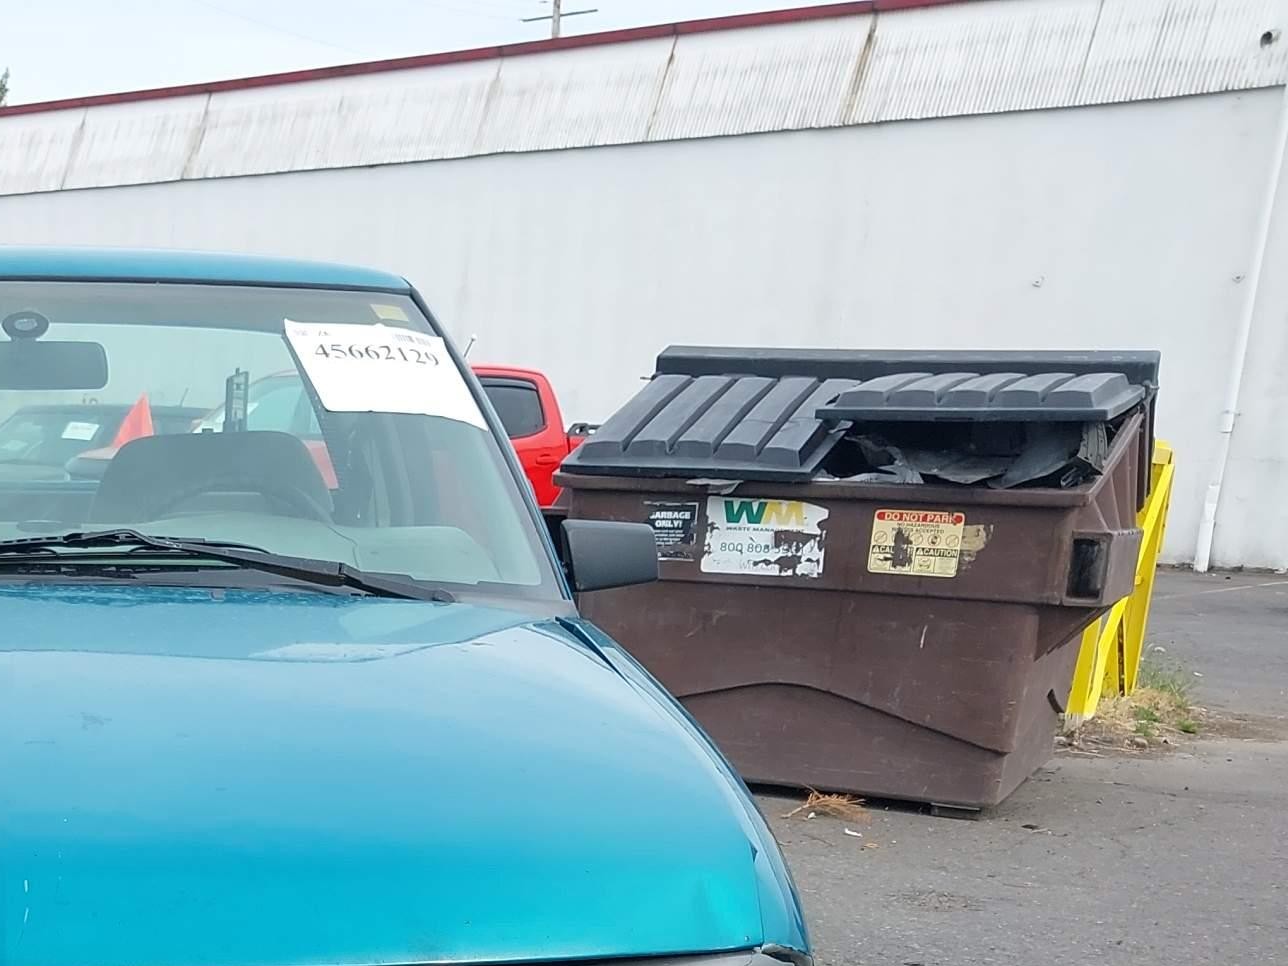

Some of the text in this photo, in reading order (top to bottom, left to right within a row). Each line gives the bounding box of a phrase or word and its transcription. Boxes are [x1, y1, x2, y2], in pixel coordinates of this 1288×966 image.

[314, 343, 440, 366] 45662129
[725, 500, 805, 525] WM
[885, 512, 957, 524] DO NOT PARK
[747, 543, 770, 554] 808
[923, 549, 958, 557] CAUTION
